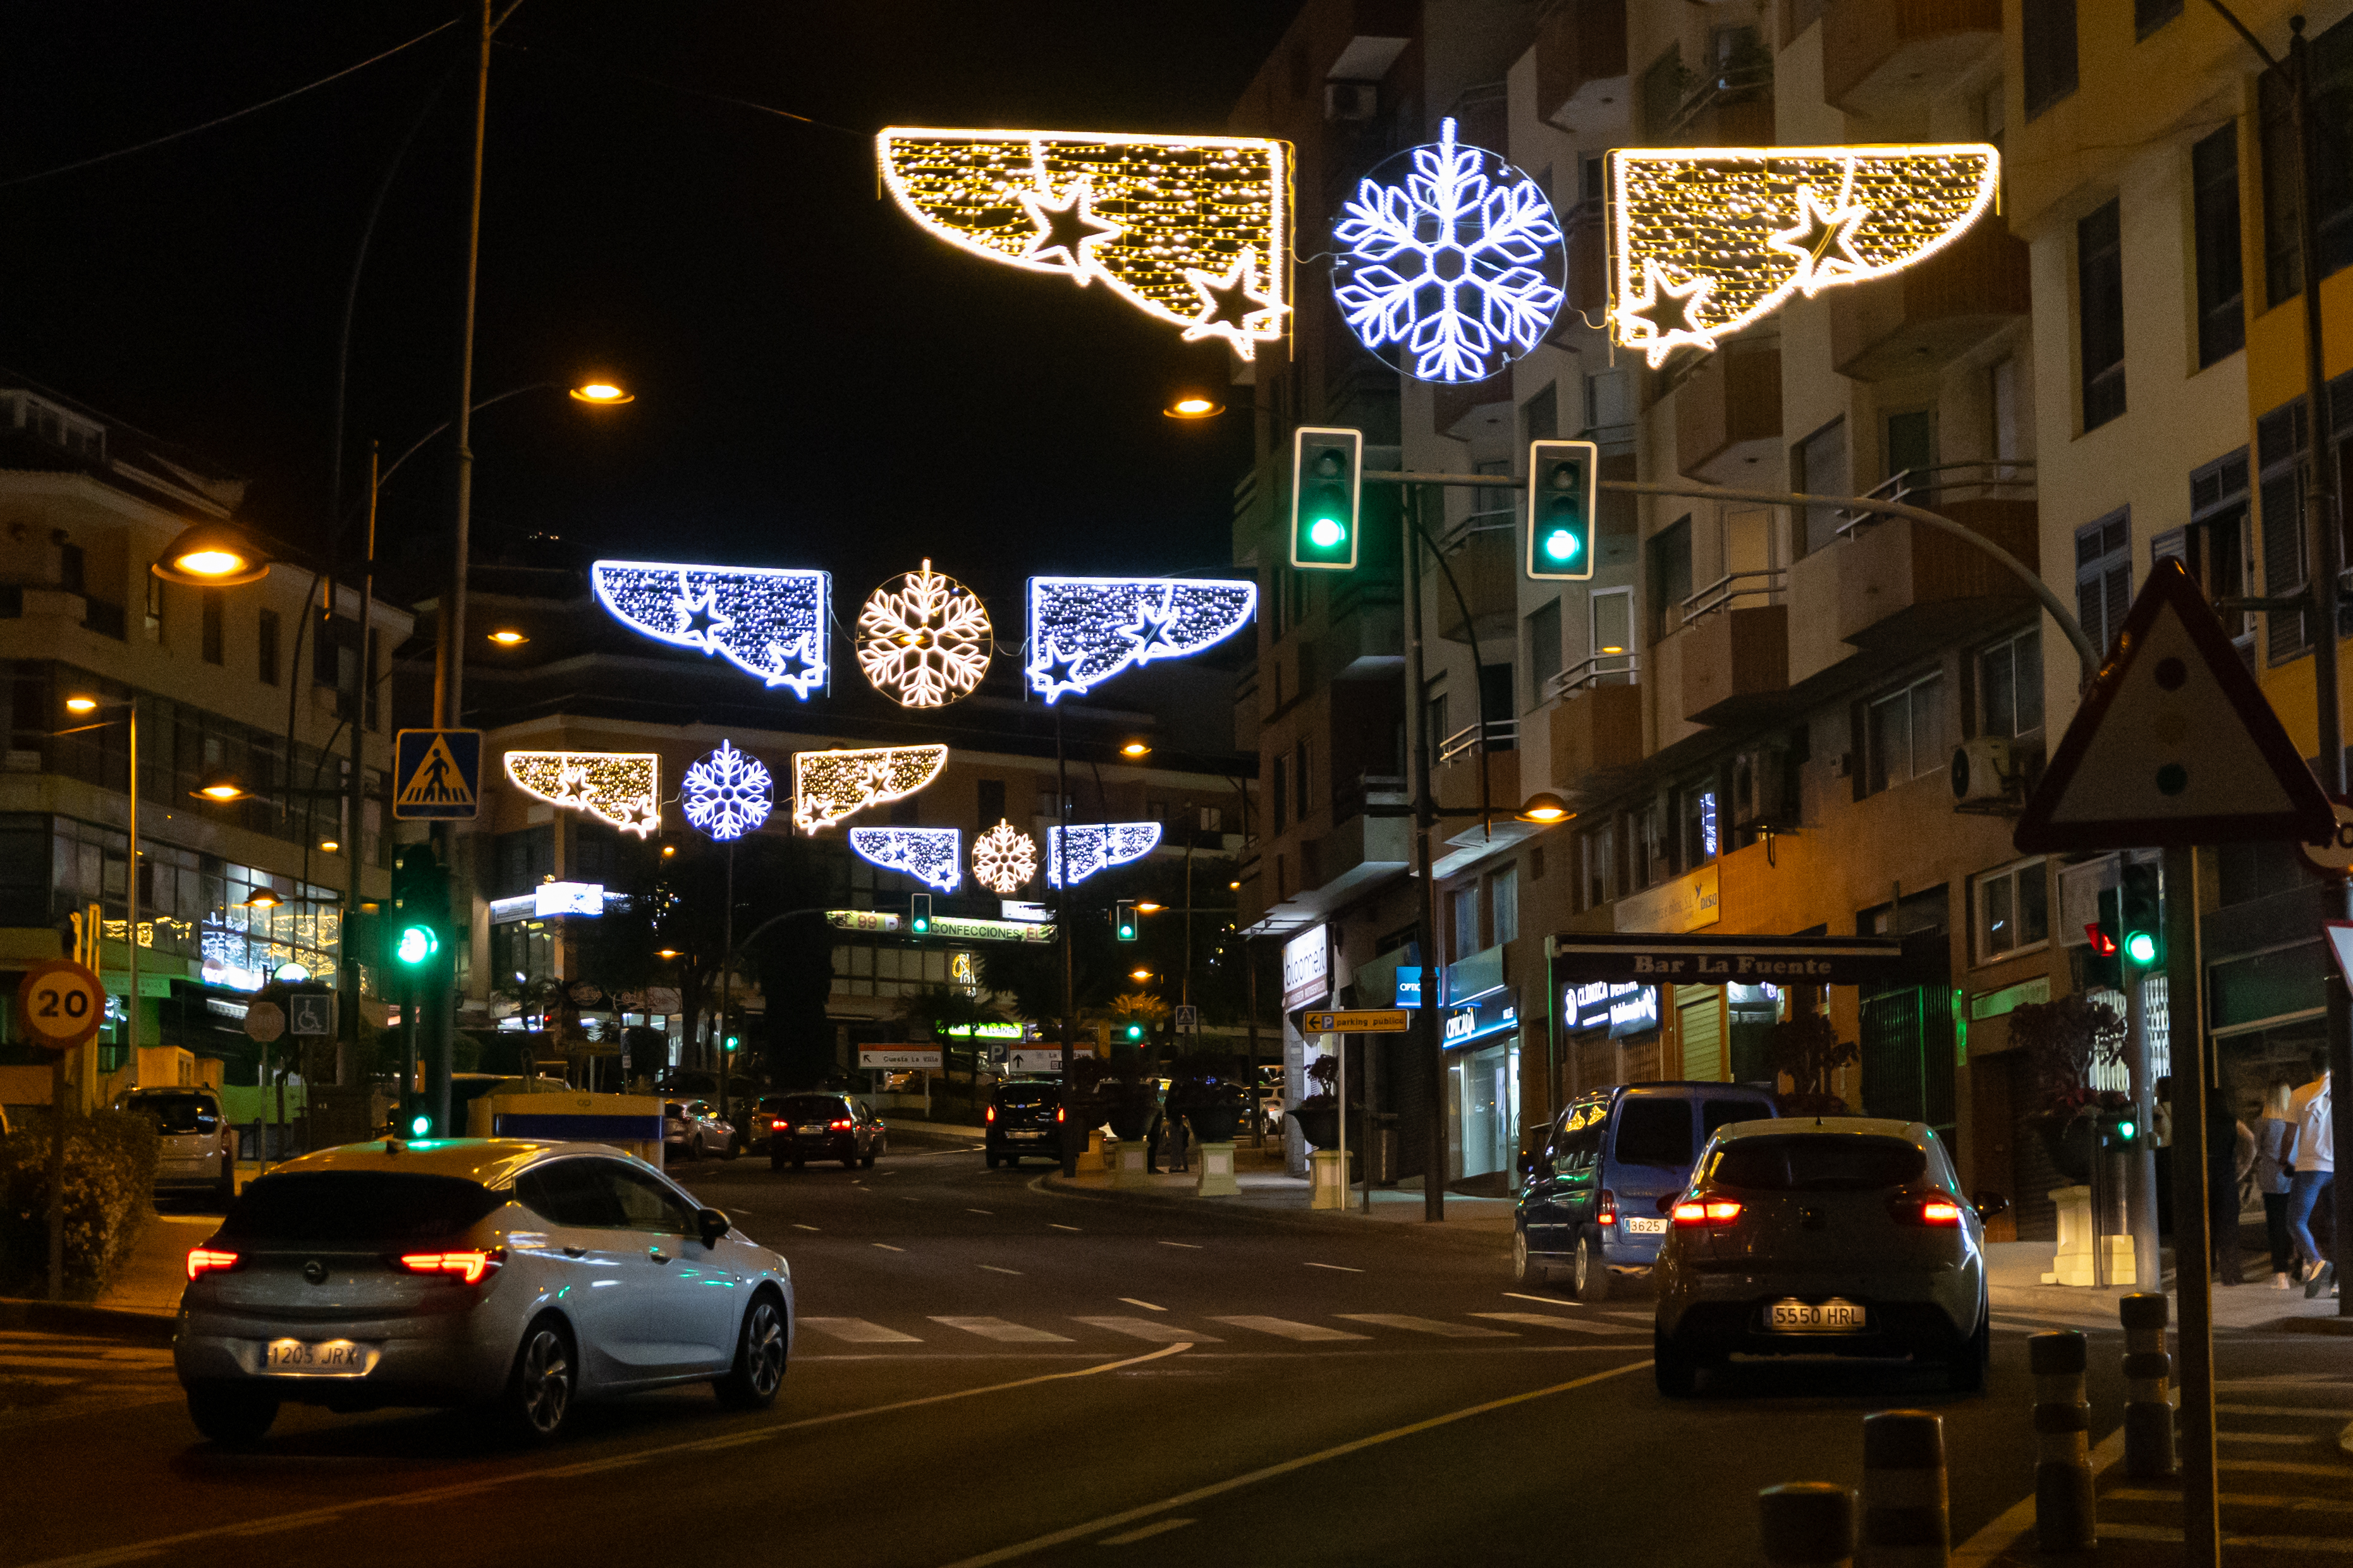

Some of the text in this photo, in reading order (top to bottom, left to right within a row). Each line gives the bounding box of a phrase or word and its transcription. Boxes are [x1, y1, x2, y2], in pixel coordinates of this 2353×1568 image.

[932, 922, 1020, 938] CONFECCIONES
[1634, 956, 1831, 975] Bar La Fuente
[1399, 983, 1421, 992] OPTIC
[1577, 981, 1608, 1007] CLÍNICA
[38, 989, 88, 1018] 20
[1337, 1018, 1368, 1027] parking
[1373, 1018, 1404, 1026] público
[991, 1045, 1004, 1062] P
[1631, 1220, 1660, 1232] 3625
[1776, 1308, 1861, 1325] 5550 HRL
